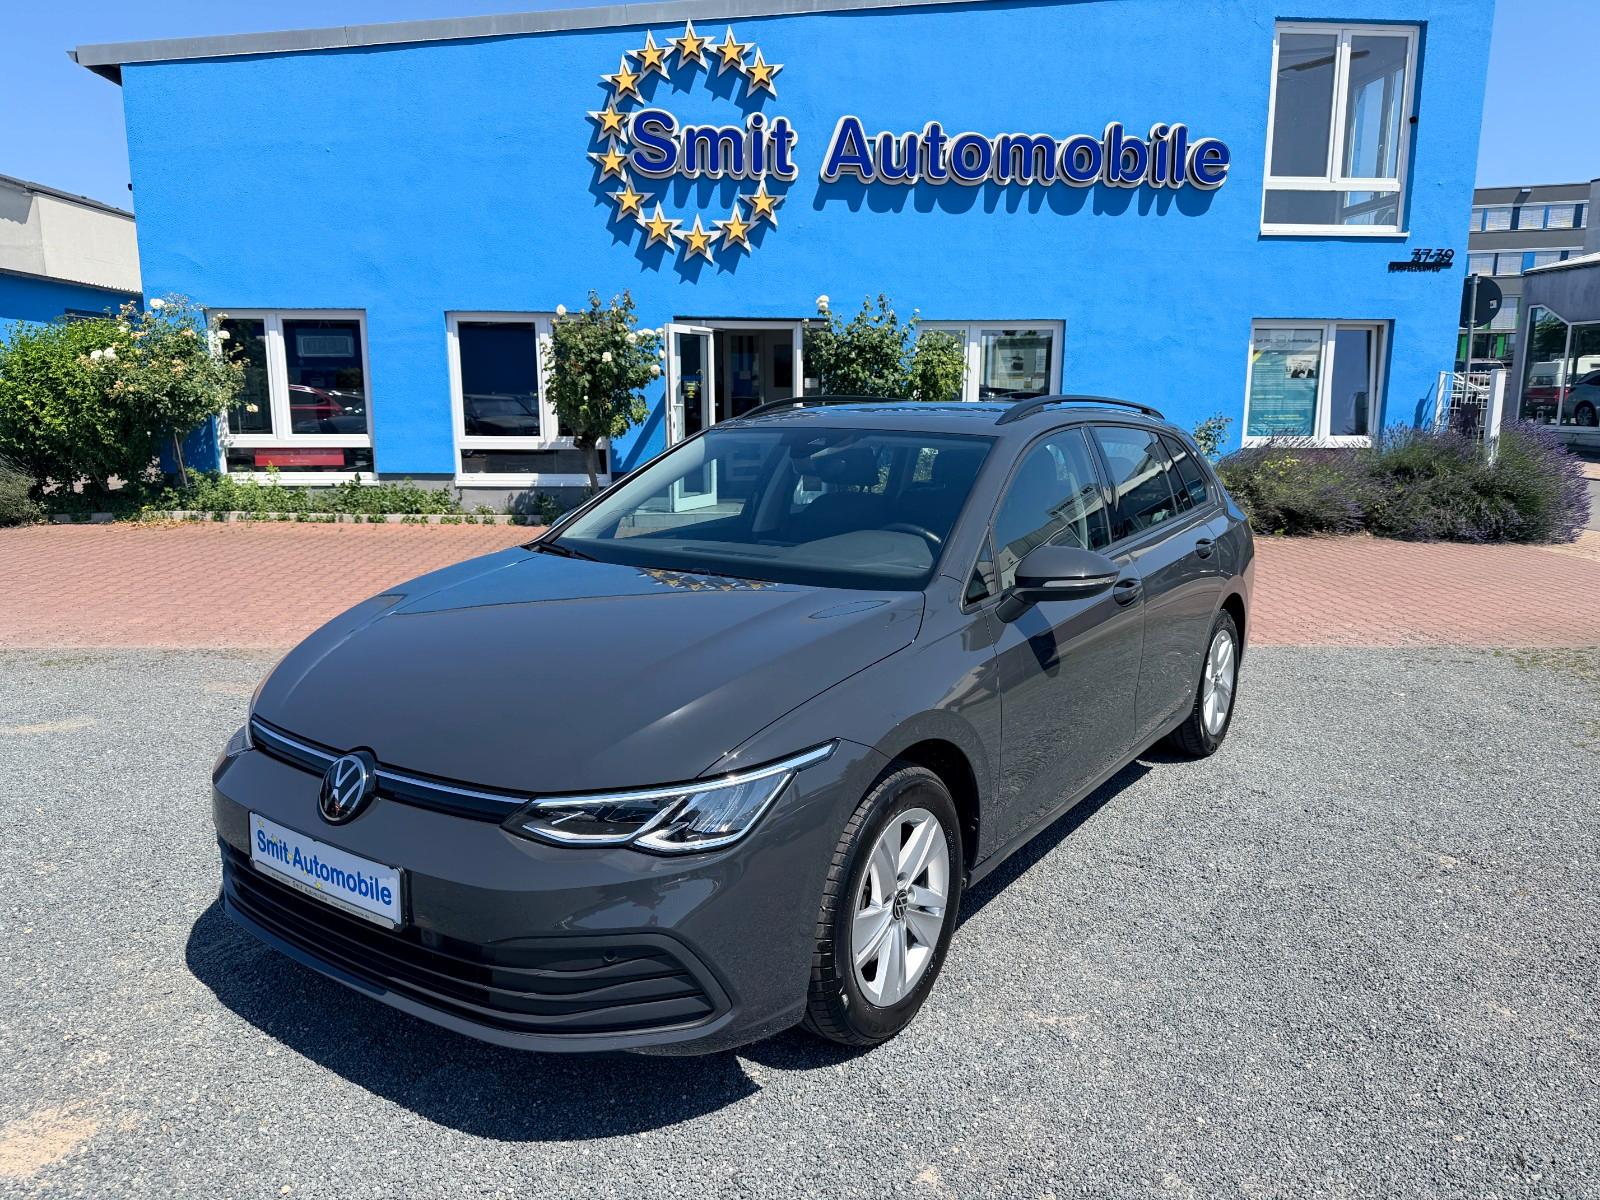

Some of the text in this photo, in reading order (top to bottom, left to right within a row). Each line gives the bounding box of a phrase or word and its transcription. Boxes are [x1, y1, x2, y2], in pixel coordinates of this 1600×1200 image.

[629, 109, 1232, 190] Smit Automobile
[257, 829, 392, 906] Smit Automobile
